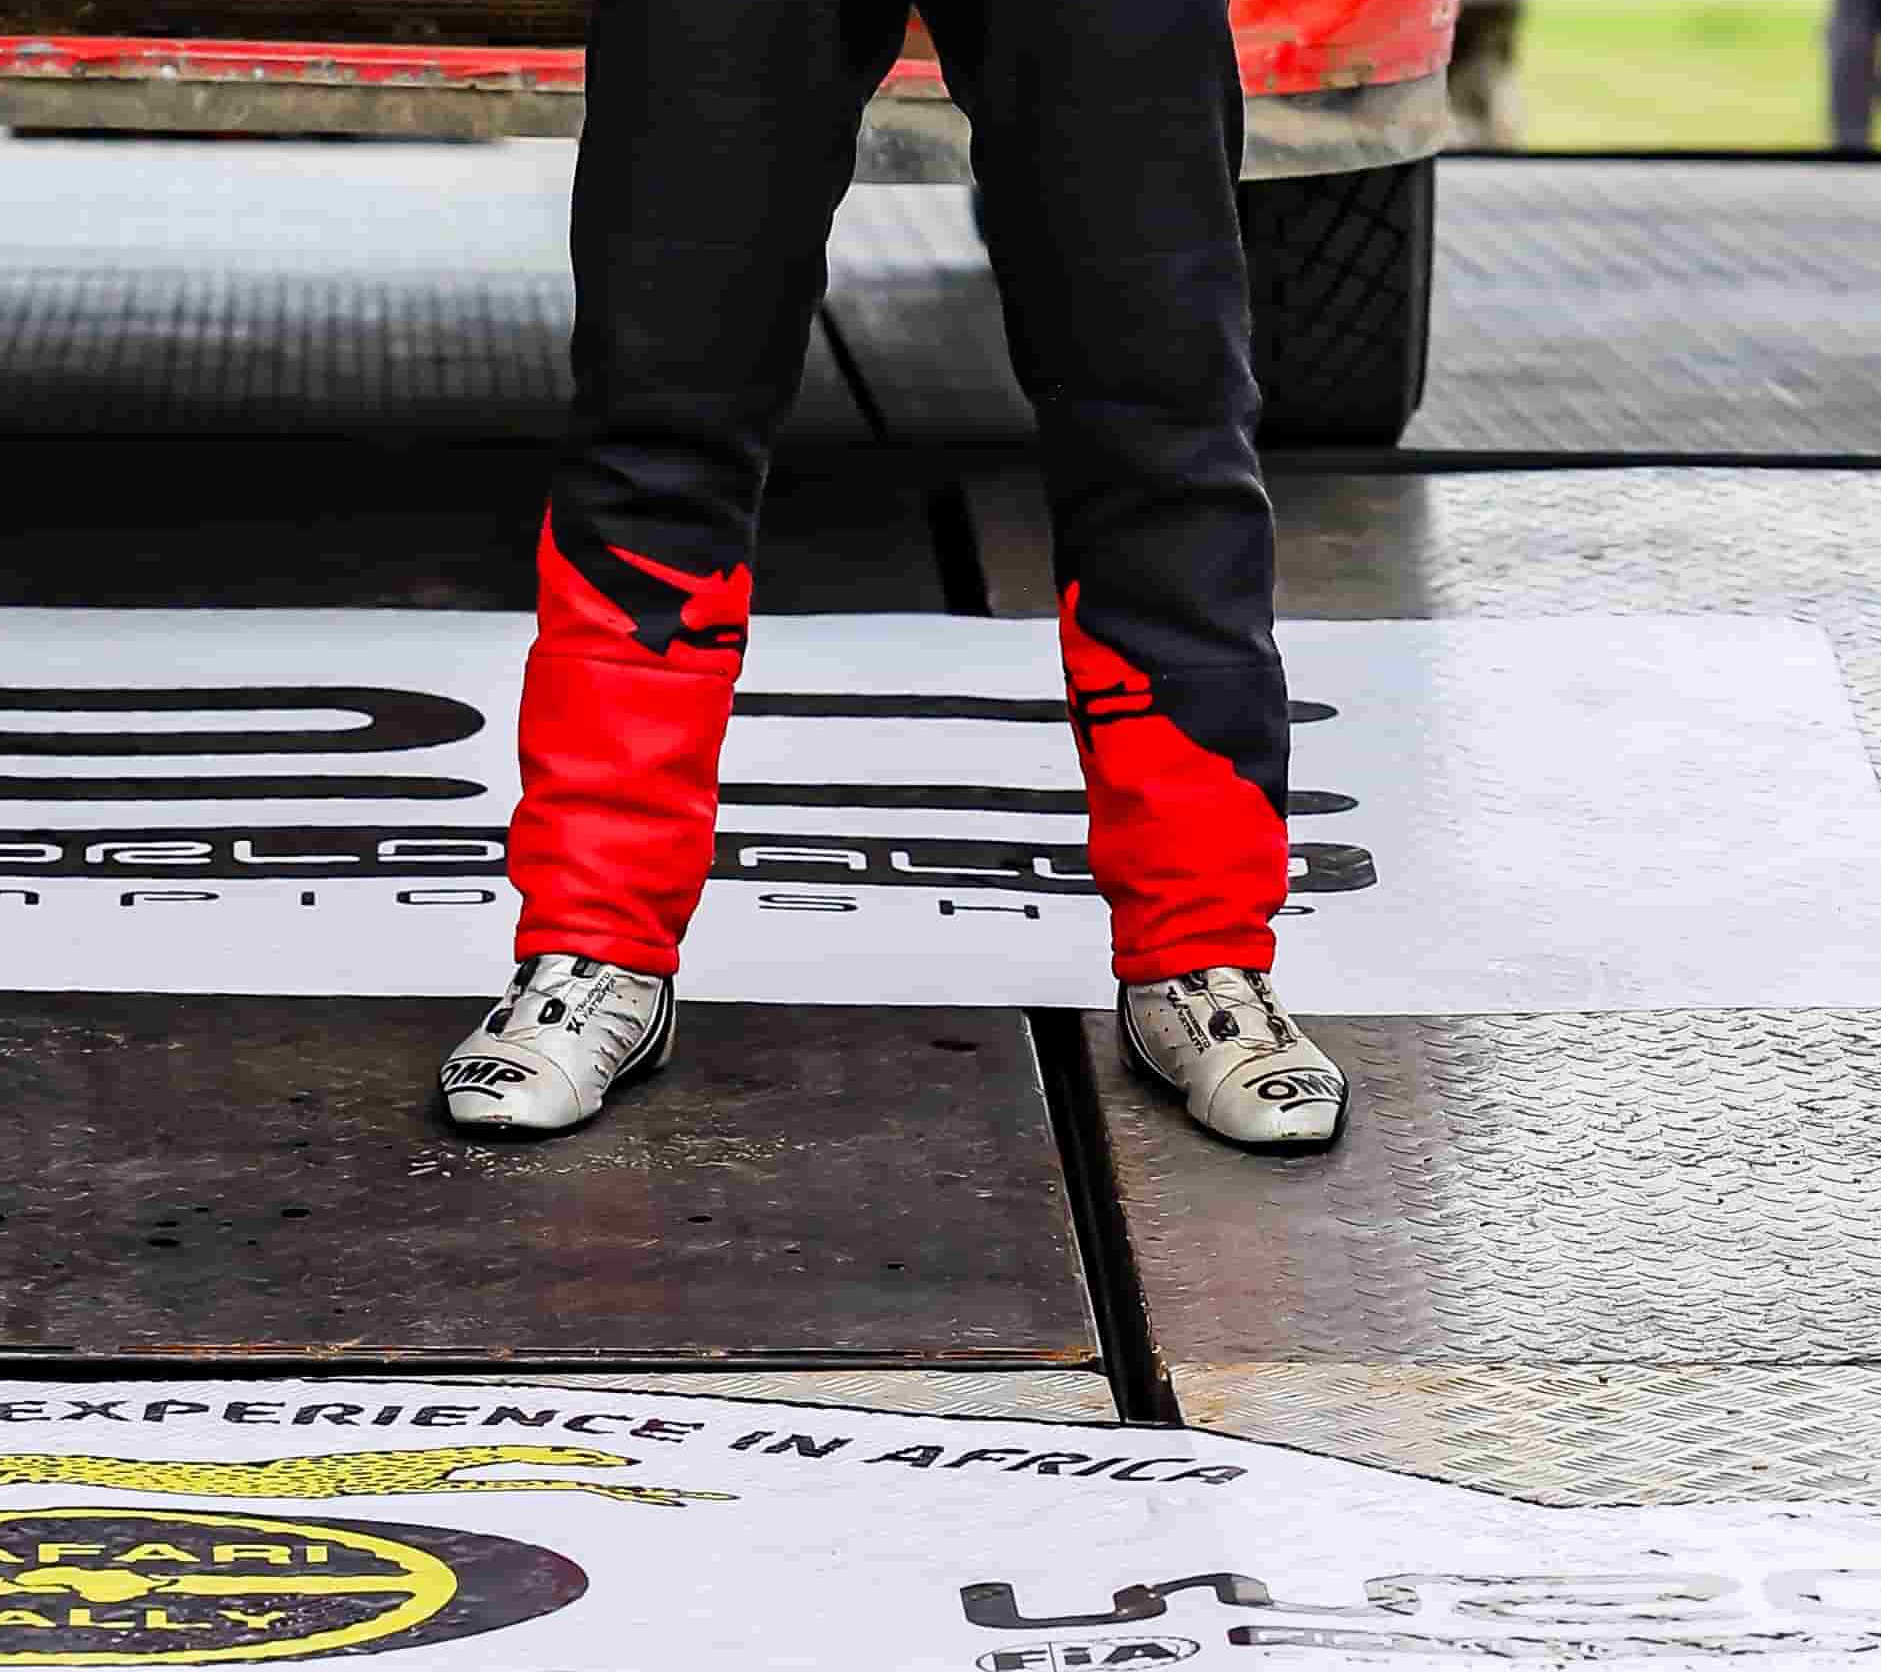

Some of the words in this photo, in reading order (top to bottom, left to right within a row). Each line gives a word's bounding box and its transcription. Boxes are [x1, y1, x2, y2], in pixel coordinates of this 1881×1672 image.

[738, 846, 1310, 880] ALL
[727, 1429, 854, 1460] IN
[863, 1443, 1250, 1487] AFRICA
